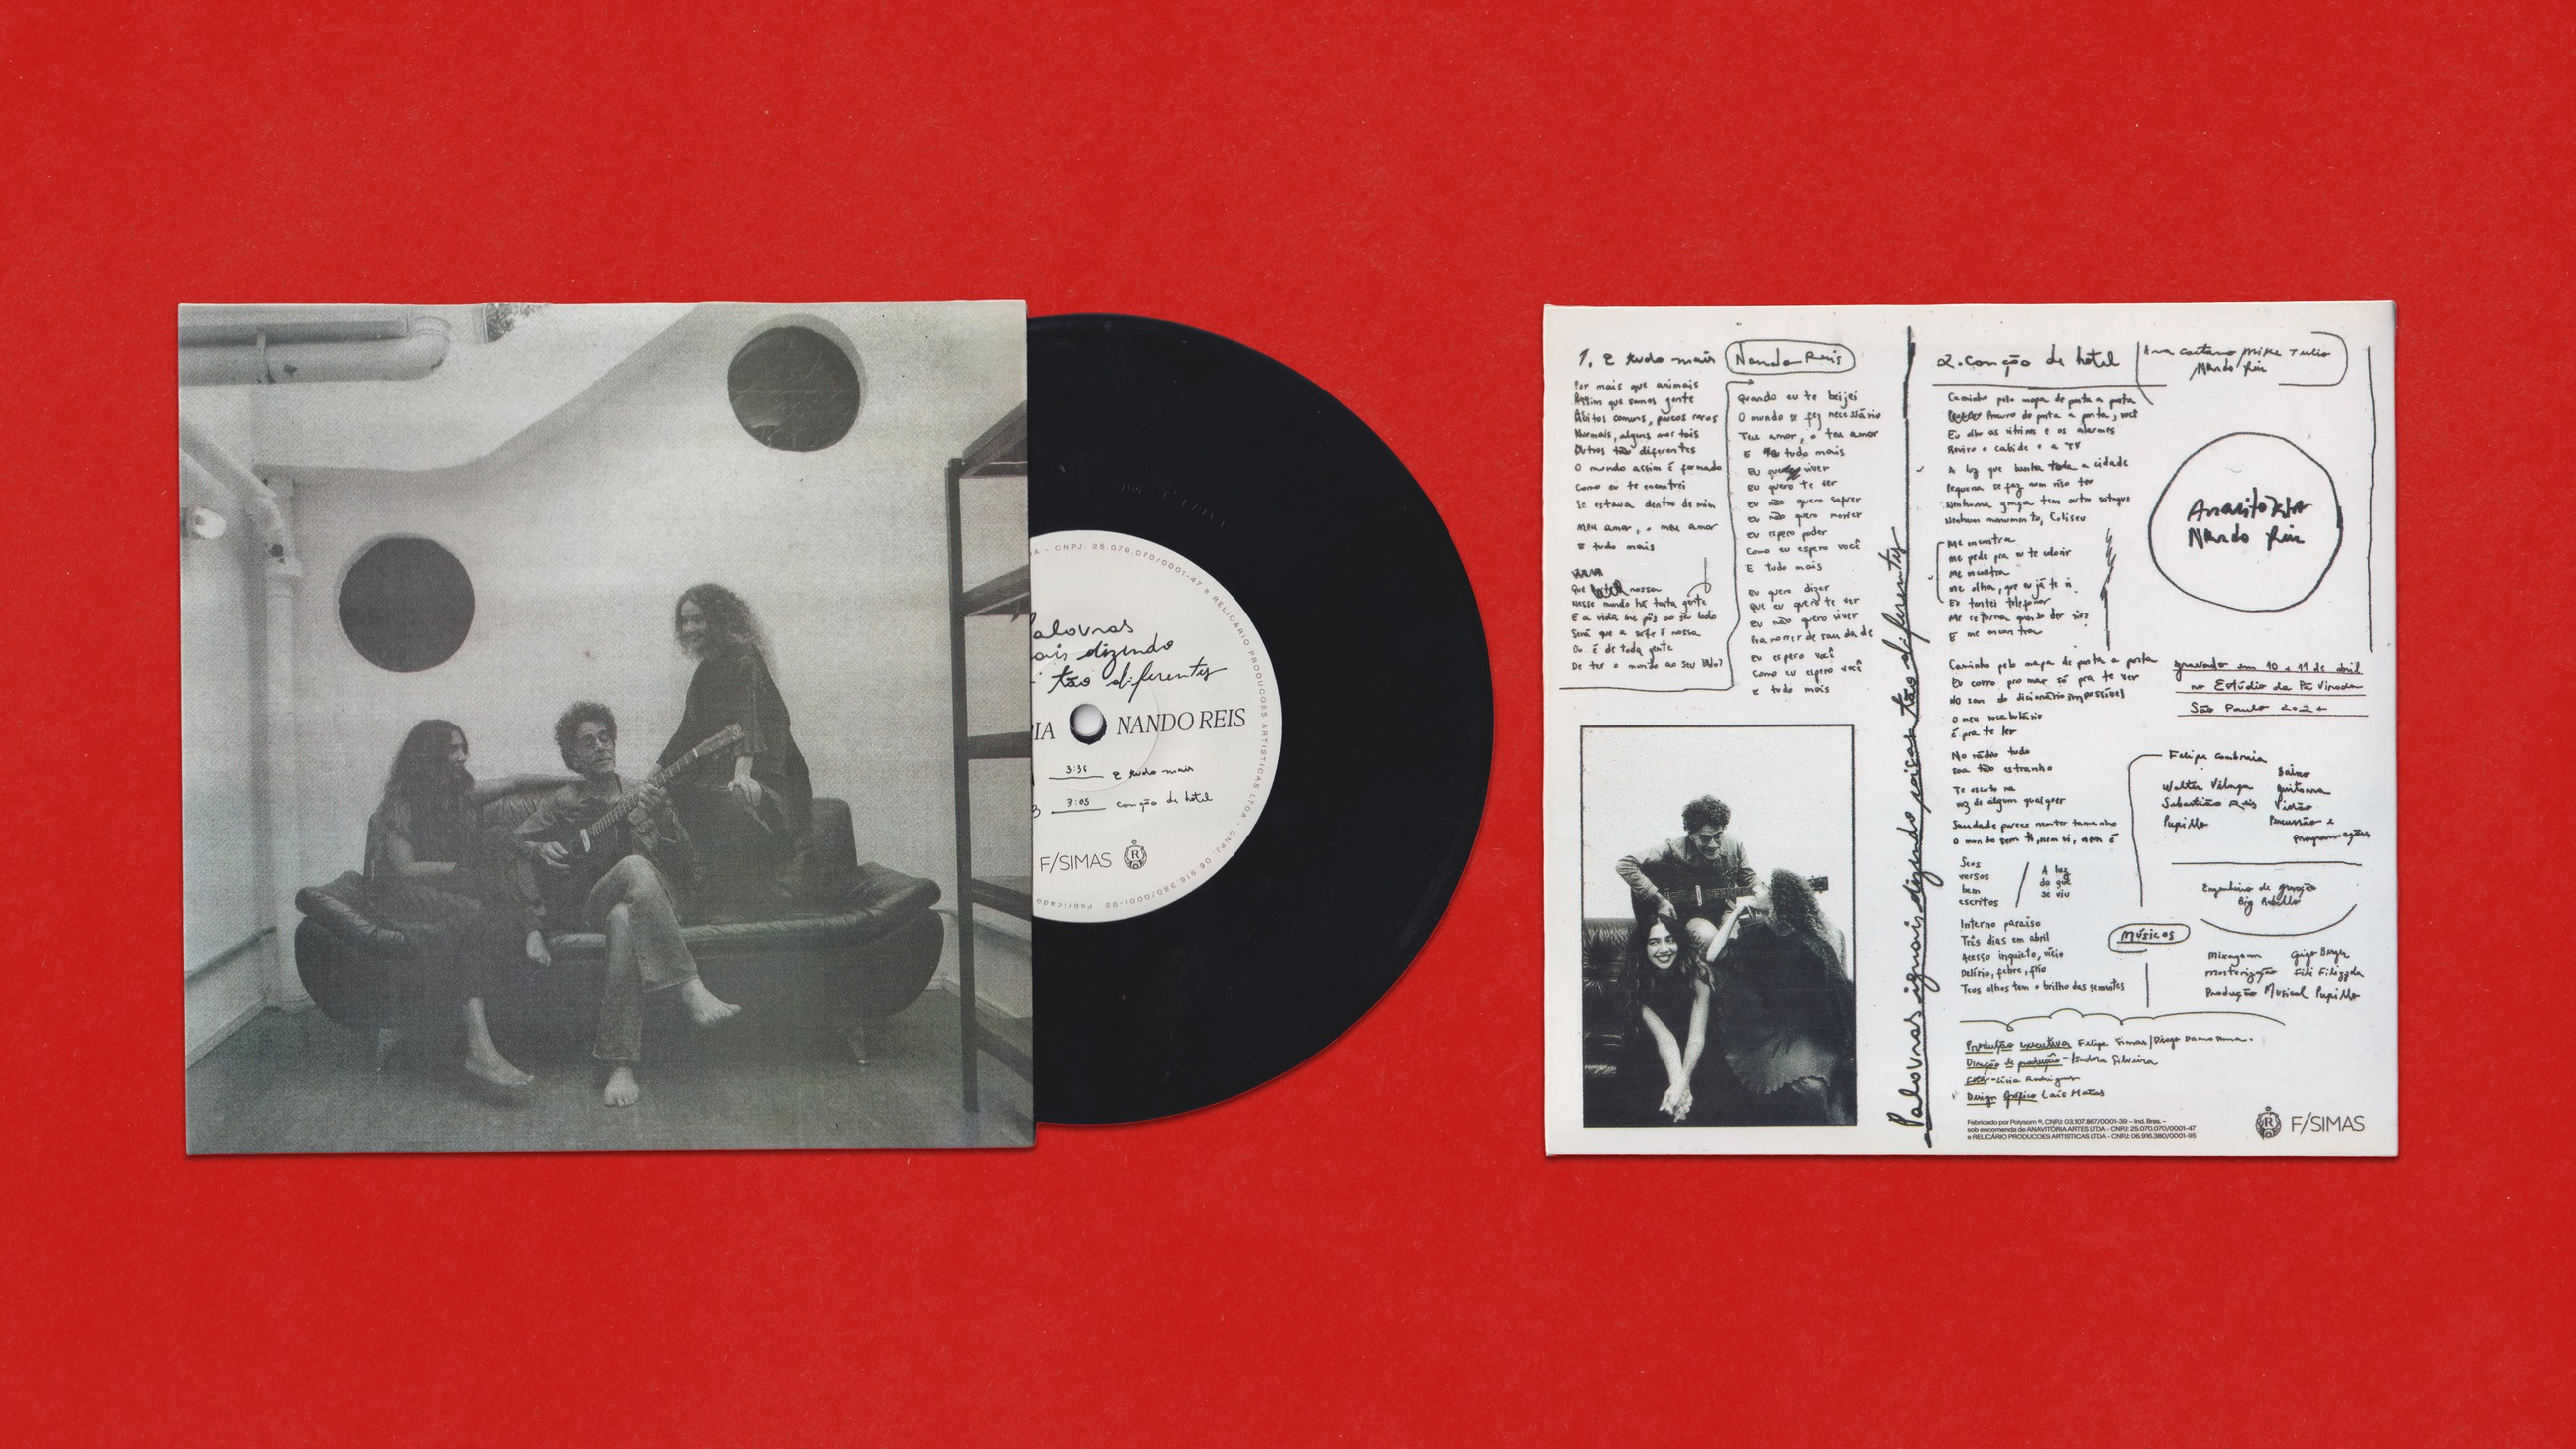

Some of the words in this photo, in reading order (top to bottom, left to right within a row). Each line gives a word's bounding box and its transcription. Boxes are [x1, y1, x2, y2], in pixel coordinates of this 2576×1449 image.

[1116, 712, 1194, 735] NANDO
[1198, 708, 1246, 729] REIS
[1254, 724, 1268, 789] ARTISTICAS
[1241, 793, 1256, 819] LTDA
[1040, 852, 1112, 874] F/SIMAS
[2291, 1112, 2365, 1134] F/SIMAS
